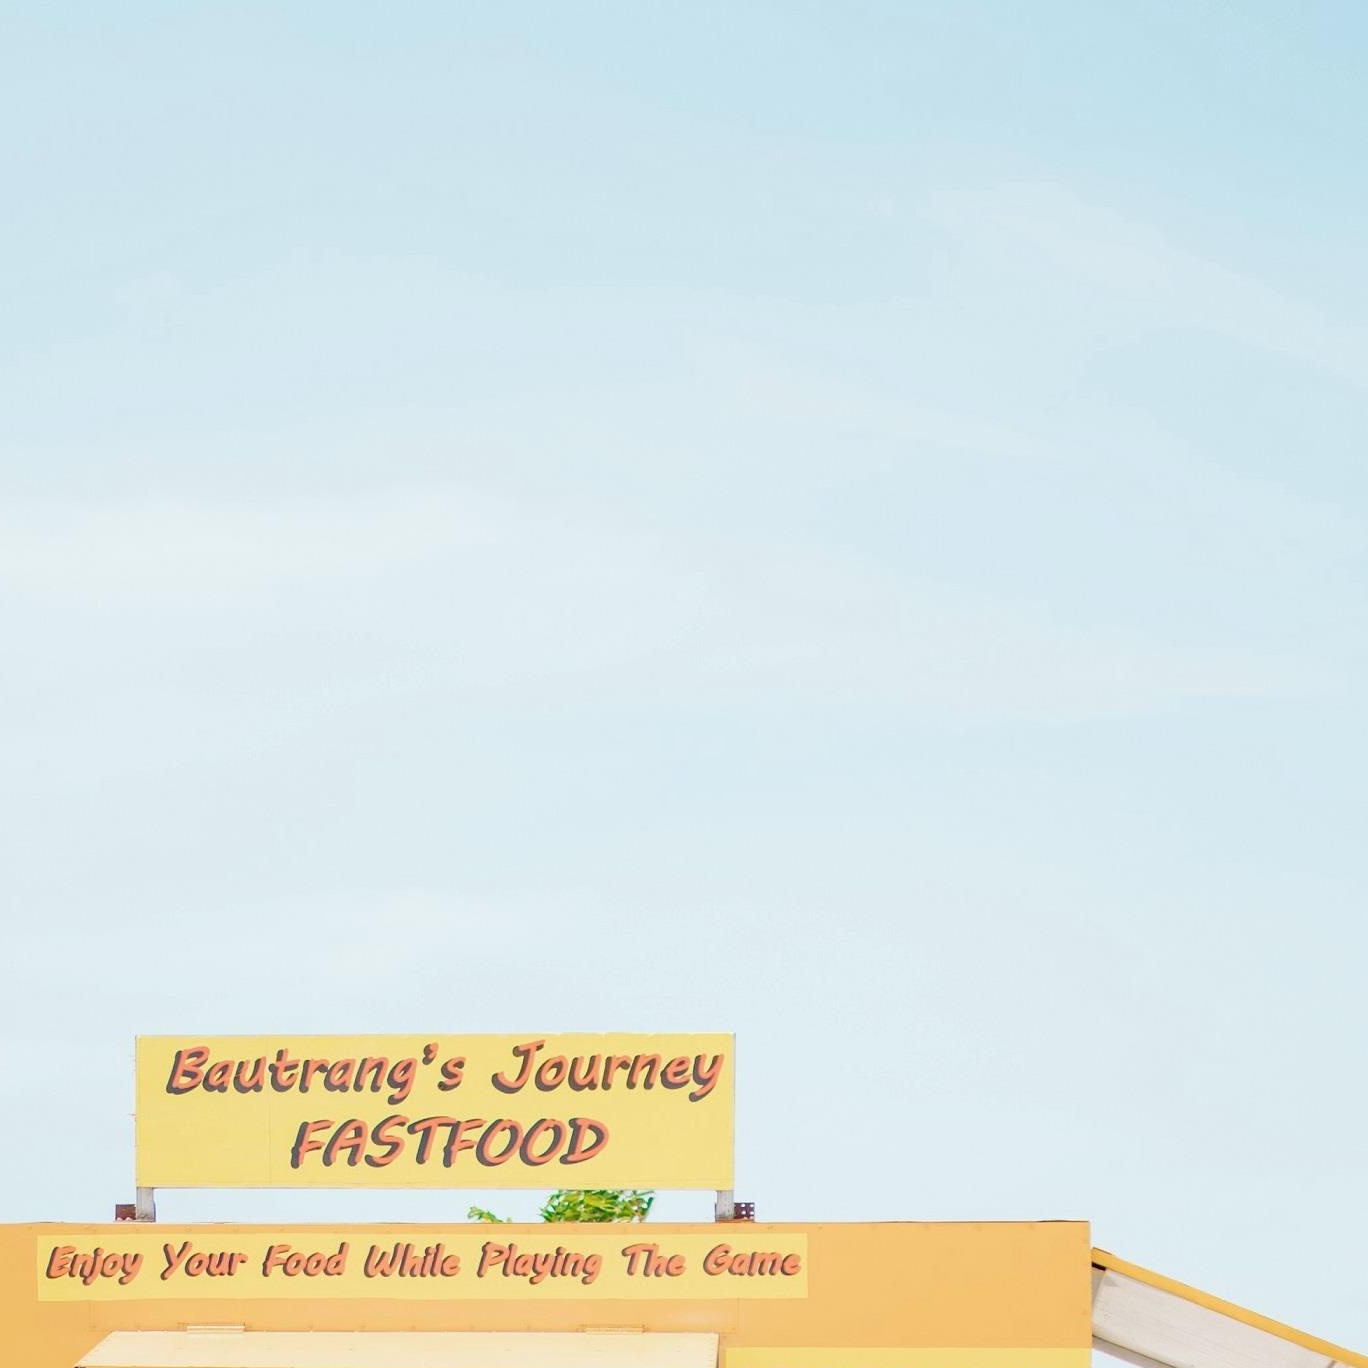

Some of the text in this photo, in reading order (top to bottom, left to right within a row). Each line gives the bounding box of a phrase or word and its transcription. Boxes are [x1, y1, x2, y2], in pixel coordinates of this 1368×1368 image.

[166, 1039, 726, 1104] Bautrang's Journey
[290, 1116, 609, 1169] FASTFOOD
[46, 1242, 803, 1285] Enjoy Your Food While Playing The Game
